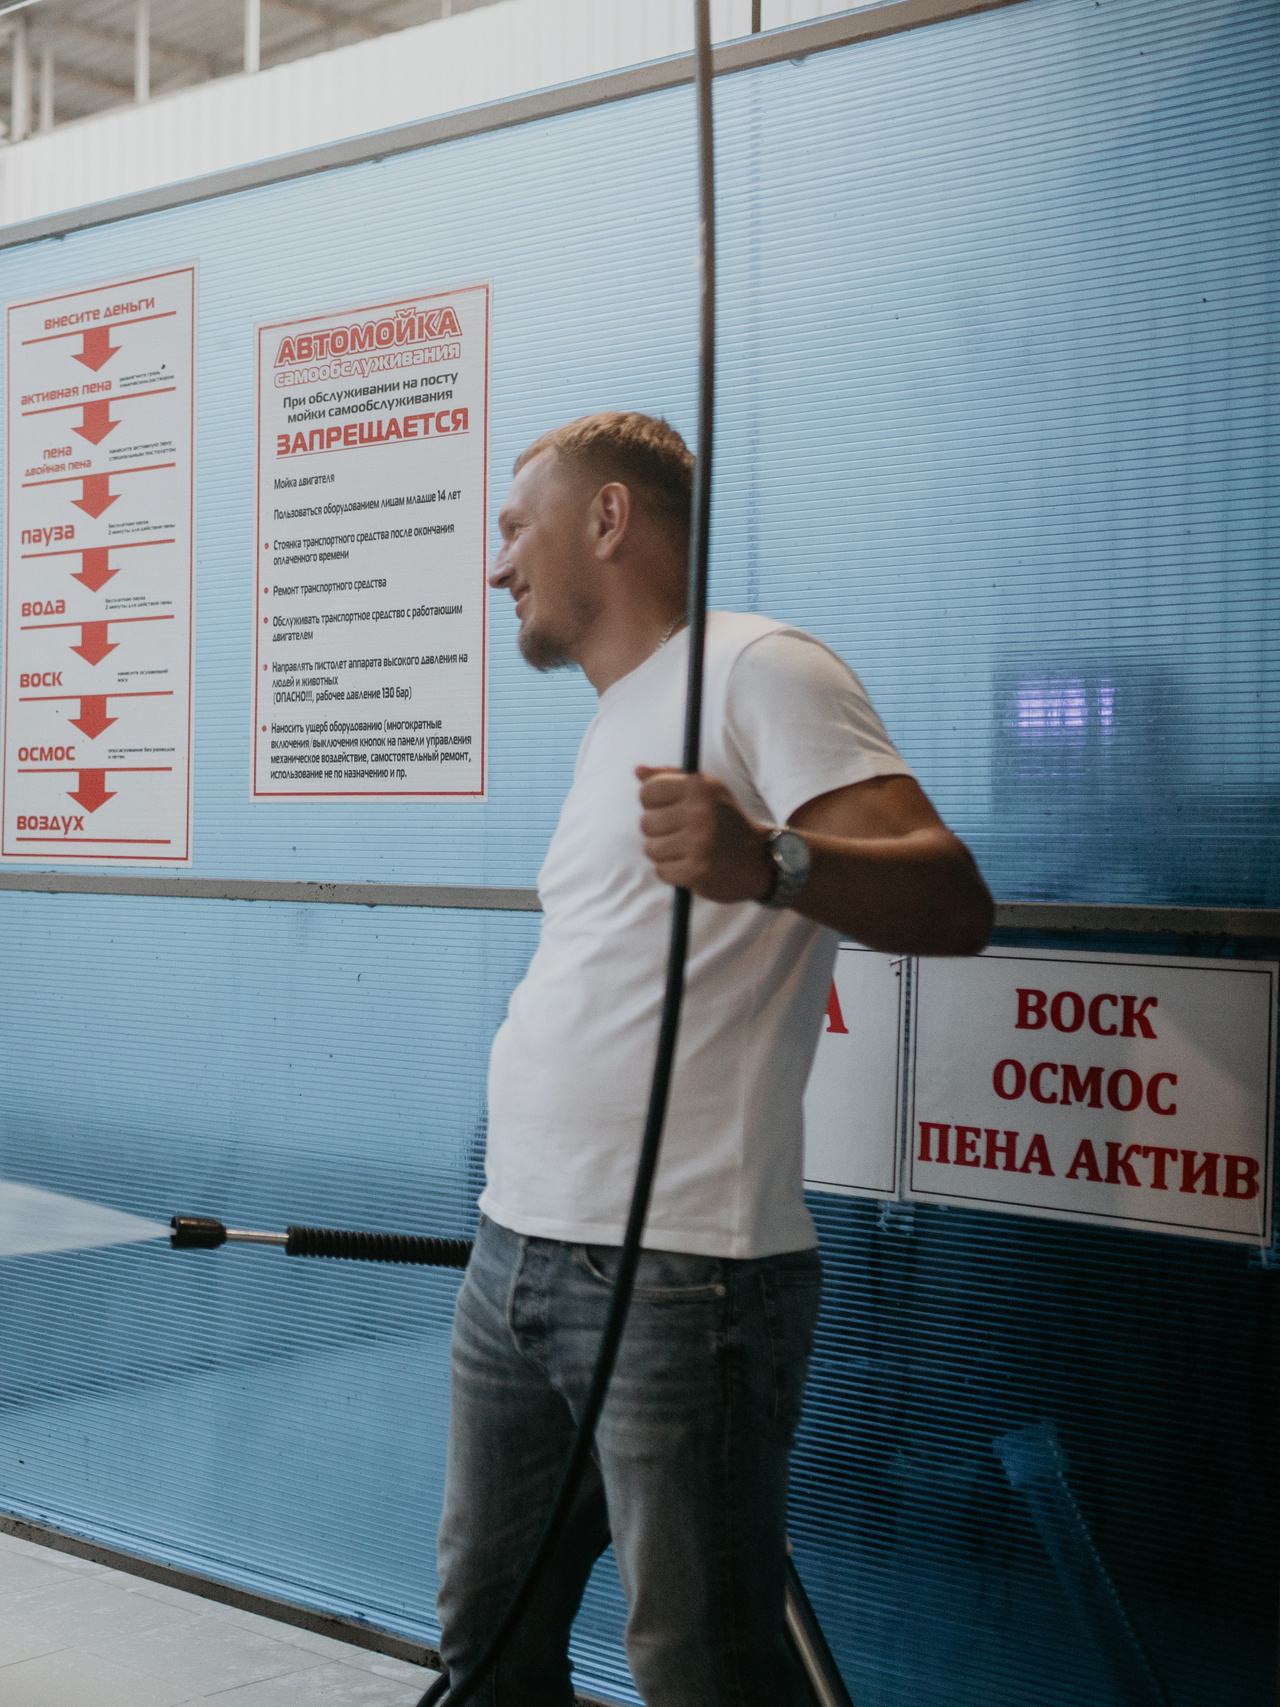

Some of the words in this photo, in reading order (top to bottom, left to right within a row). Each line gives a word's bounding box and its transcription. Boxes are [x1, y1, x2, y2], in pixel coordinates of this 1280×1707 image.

[44, 308, 100, 330] внесите
[103, 297, 154, 318] деньги
[274, 307, 463, 368] АВТОМОЙКА
[274, 342, 461, 388] самообслуживания
[20, 386, 79, 405] активная
[81, 380, 112, 395] пена
[283, 396, 306, 409] При
[308, 381, 400, 404] обслуживании
[402, 379, 417, 390] на
[420, 372, 458, 387] посту
[287, 407, 325, 423] мойки
[328, 389, 452, 417] самообслуживания
[277, 407, 469, 456] ЗАПРЕЩАЕТСЯ
[43, 446, 72, 459] пена
[24, 463, 66, 477] двойная
[68, 459, 92, 470] пена
[274, 477, 297, 489] Мойка
[298, 474, 334, 487] двигателя
[273, 506, 322, 520] Пользоваться
[323, 500, 379, 515] оборудованием
[380, 497, 405, 508] лицам
[406, 493, 436, 505] младше
[437, 489, 446, 501] 14
[447, 490, 461, 500] лет
[21, 524, 75, 547] пауза
[273, 539, 301, 550] Стоянка
[302, 534, 355, 550] транспортного
[356, 530, 389, 544] средства
[390, 528, 412, 539] после
[413, 523, 454, 536] окончания
[273, 553, 317, 565] оплаченного
[318, 550, 349, 563] времени
[273, 585, 299, 596] Ремонт
[300, 581, 353, 596] транспортного
[353, 578, 387, 592] средства
[272, 615, 320, 628] Обслуживать
[321, 611, 370, 625] транспортное
[371, 608, 405, 622] средство
[406, 608, 410, 618] с
[272, 631, 313, 642] двигателем
[272, 661, 313, 674] Направлять
[314, 660, 347, 670] пистолет
[348, 658, 382, 670] аппарата
[383, 656, 419, 667] высокого
[420, 654, 457, 665] давления
[458, 653, 468, 663] на
[271, 676, 294, 688] людей
[295, 678, 300, 686] и
[301, 676, 338, 686] животных
[315, 689, 345, 703] рабочее
[345, 690, 381, 700] давление
[381, 686, 394, 698] 130
[395, 686, 412, 700] бар)
[271, 722, 304, 733] Наносить
[329, 720, 382, 734] оборудованию
[383, 719, 442, 732] (многократные
[270, 738, 358, 749] включения/выключения
[359, 737, 386, 747] кнопок
[387, 737, 396, 746] на
[397, 736, 424, 746] панели
[425, 735, 472, 748] управления
[270, 754, 320, 764] механическое
[321, 751, 369, 764] воздействие,
[370, 749, 439, 762] самостоятельный
[270, 769, 323, 779] использование
[324, 769, 333, 778] не
[333, 769, 343, 778] по
[343, 769, 388, 778] назначению
[389, 769, 395, 777] и
[395, 769, 407, 780] пр.
[1015, 988, 1158, 1039] ВОСК
[993, 1059, 1178, 1115] ОСМОС
[918, 1121, 1053, 1177] ПЕНА
[1065, 1139, 1260, 1200] АКТИВ
